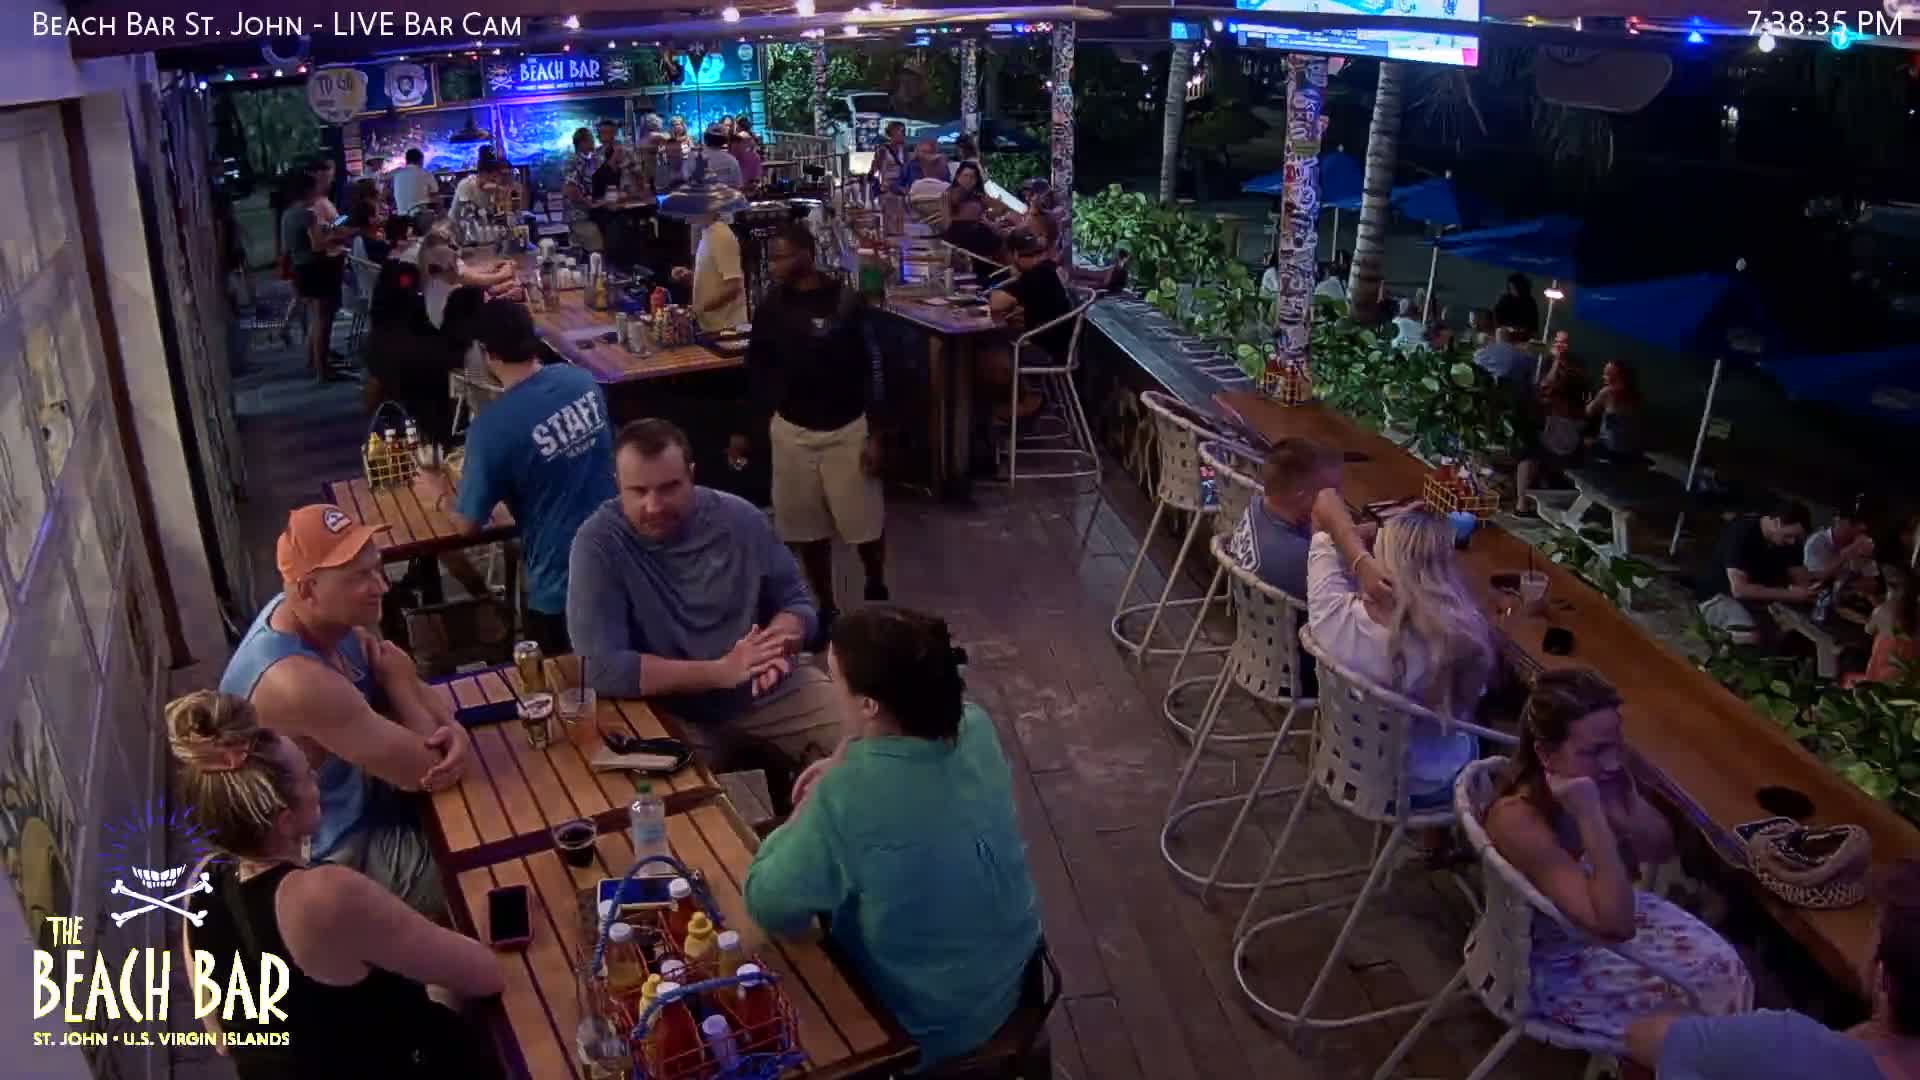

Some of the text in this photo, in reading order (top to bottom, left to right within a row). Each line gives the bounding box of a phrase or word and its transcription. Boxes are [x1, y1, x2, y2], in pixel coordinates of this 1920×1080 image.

[520, 59, 601, 81] BEACH BAR
[532, 391, 602, 457] STAFF
